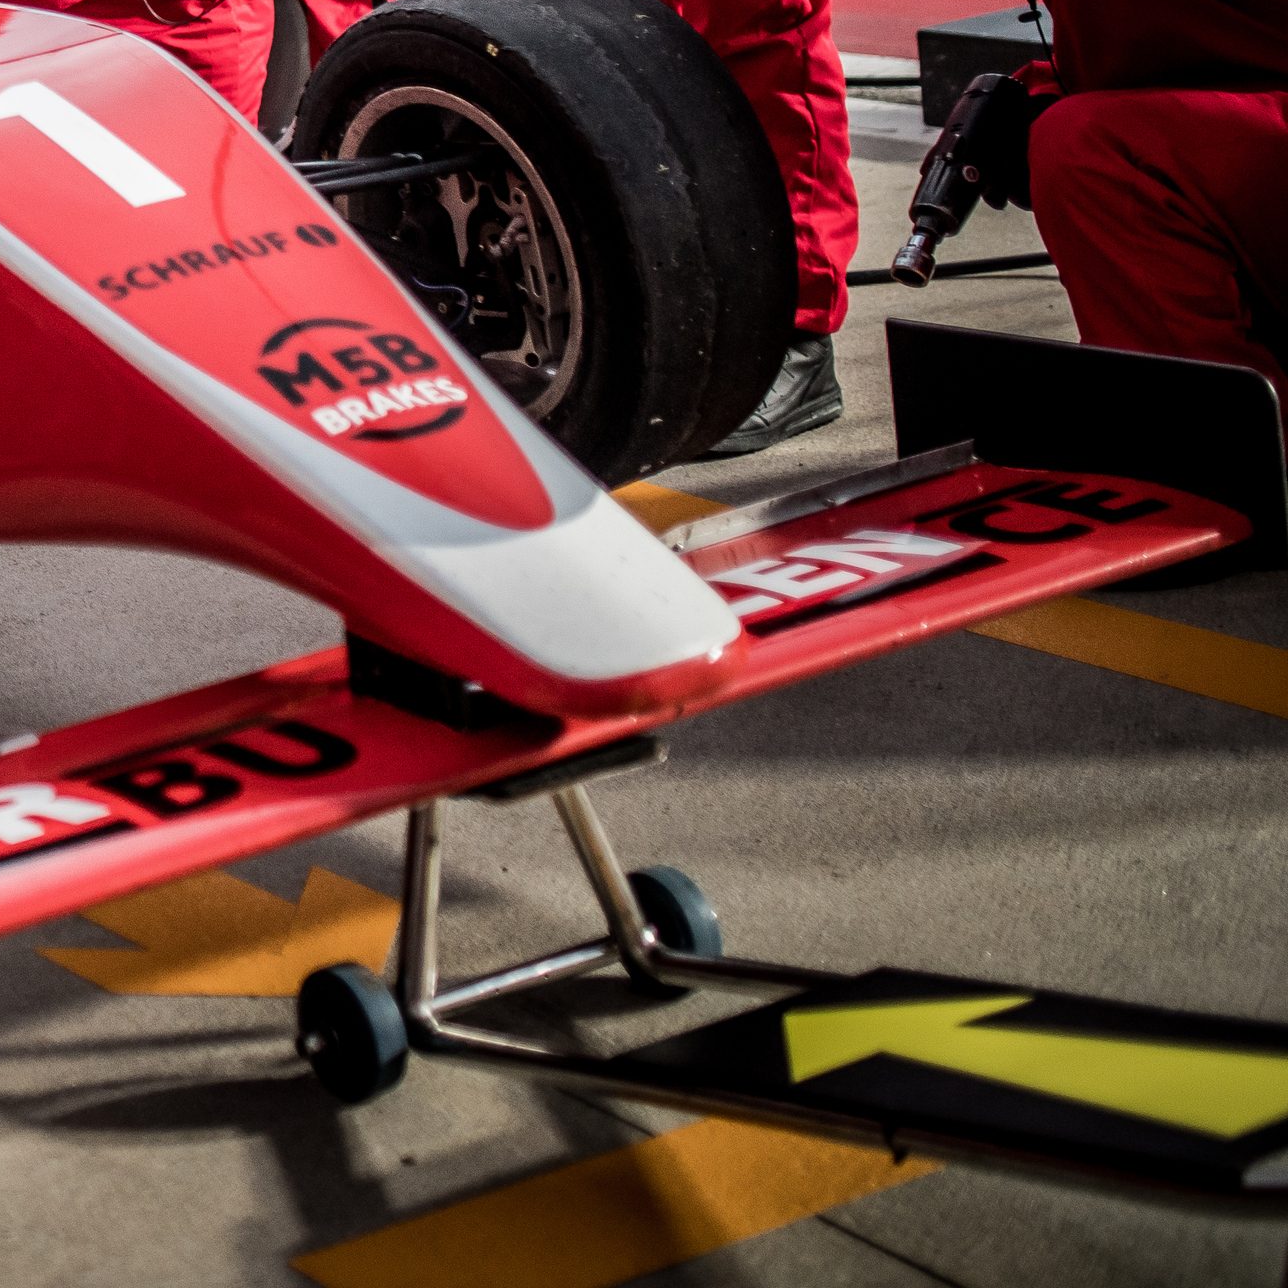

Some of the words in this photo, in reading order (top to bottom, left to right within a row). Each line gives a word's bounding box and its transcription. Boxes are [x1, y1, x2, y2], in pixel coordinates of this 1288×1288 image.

[97, 231, 290, 301] SCHRAUF
[257, 333, 439, 407] M5B
[311, 376, 469, 437] BRAKES
